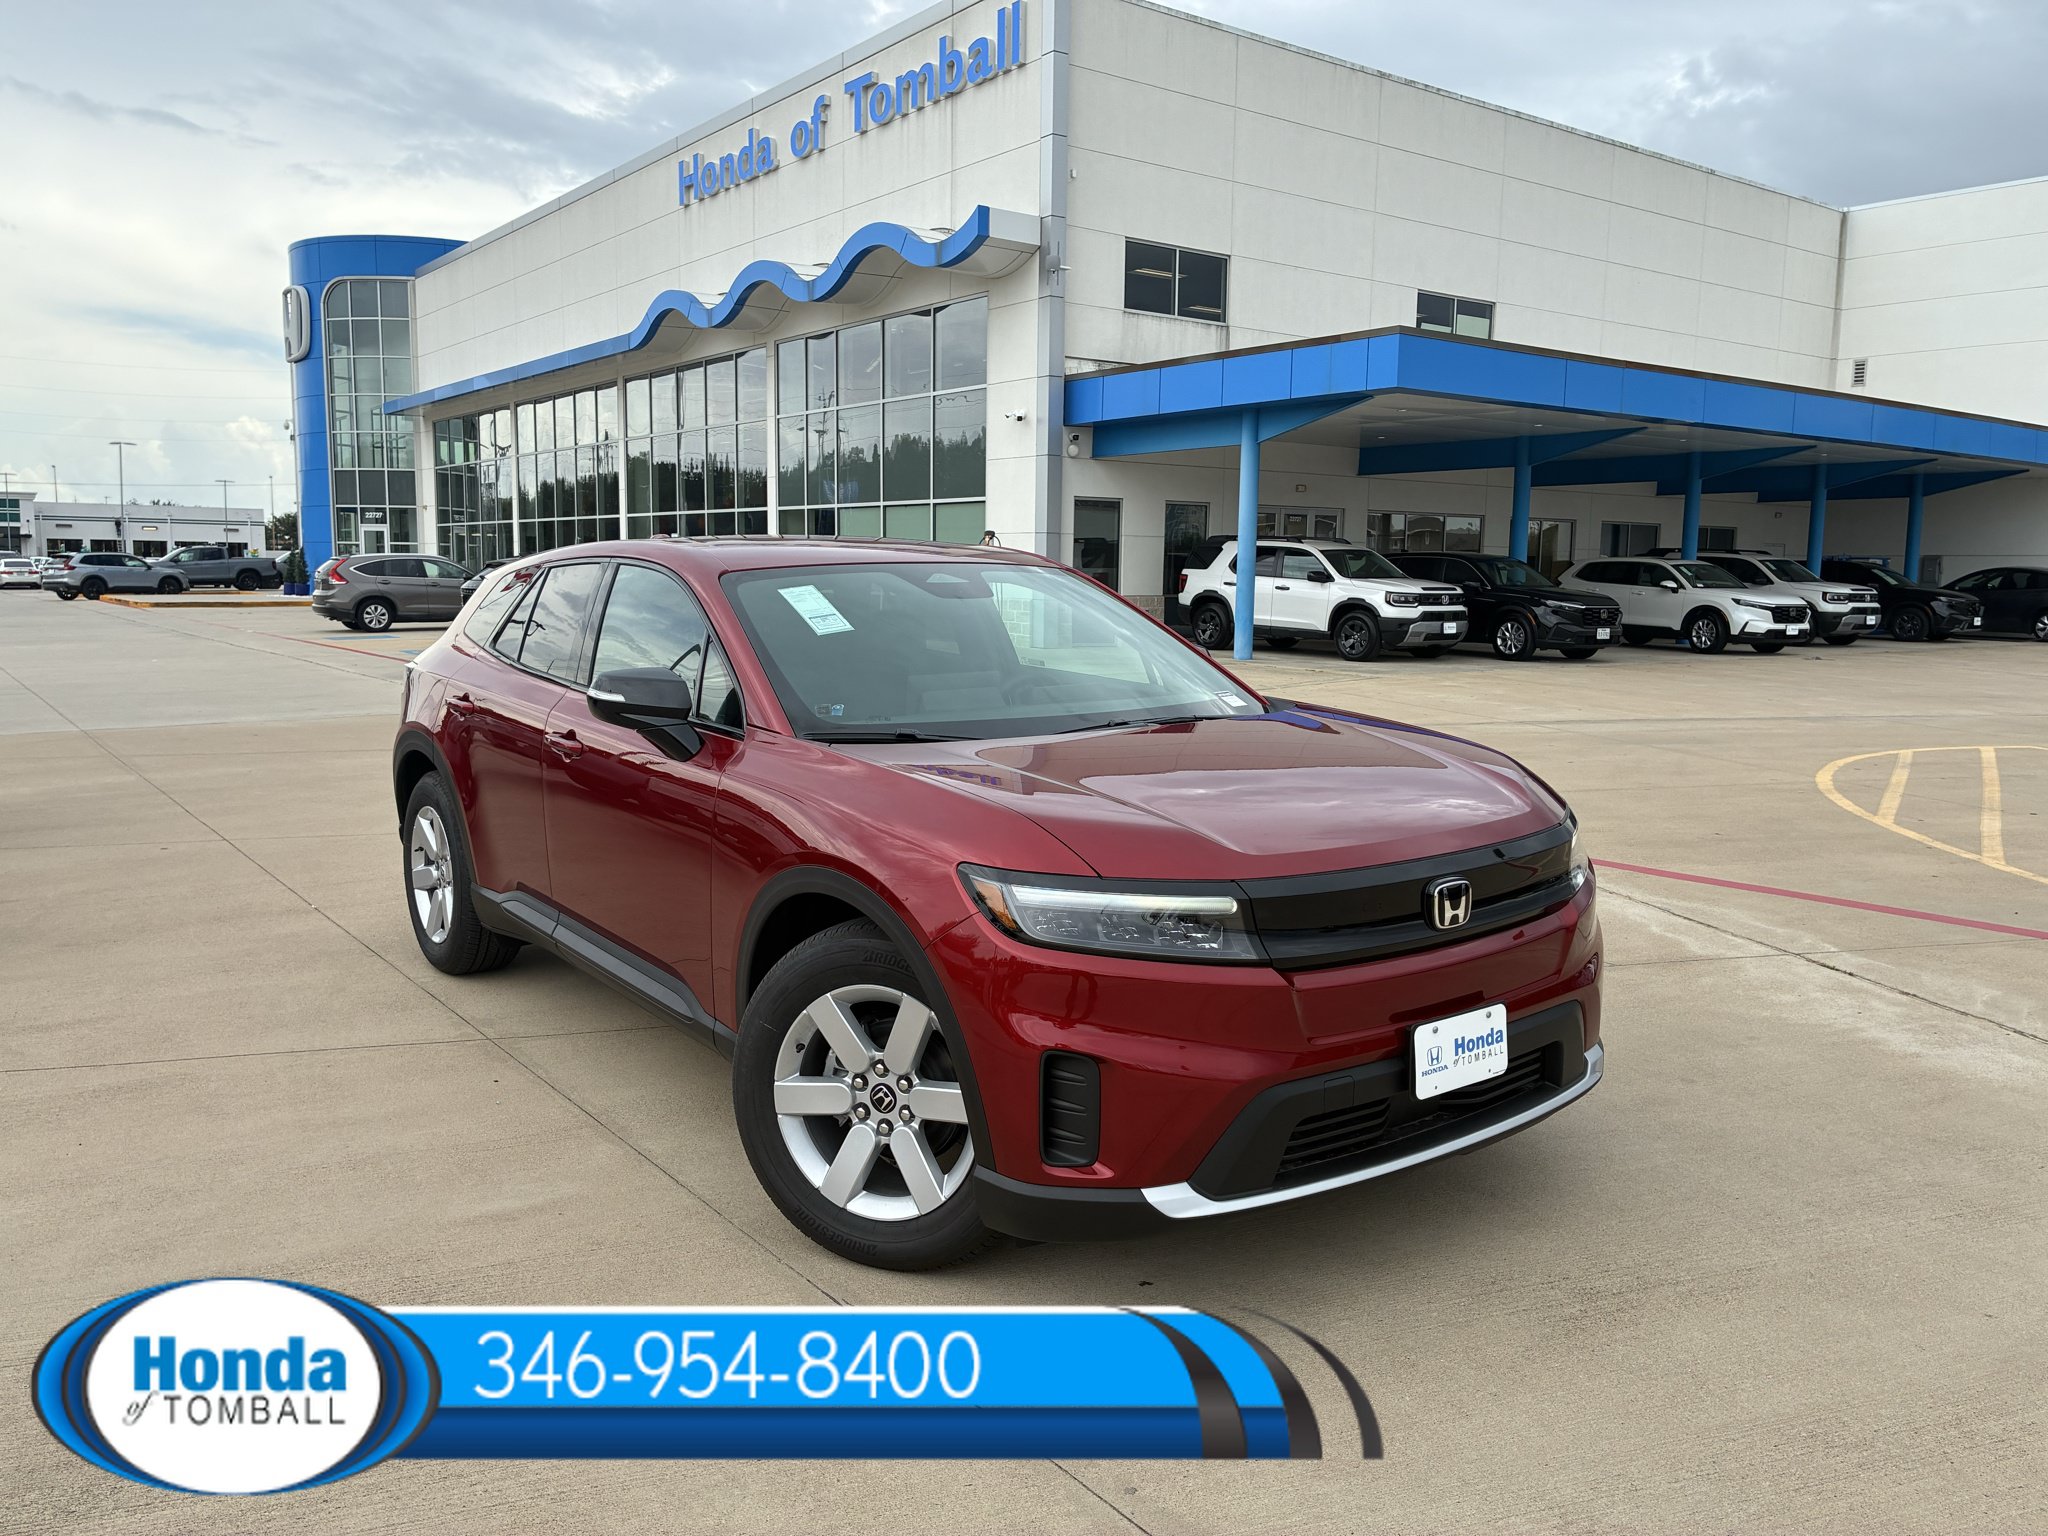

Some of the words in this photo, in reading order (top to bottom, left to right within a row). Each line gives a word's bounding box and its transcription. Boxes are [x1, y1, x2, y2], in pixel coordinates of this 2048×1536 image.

[678, 127, 779, 208] Honda
[790, 94, 831, 159] of
[844, 0, 1027, 135] Tomball
[1453, 1027, 1504, 1057] Honda
[1461, 1045, 1505, 1067] TOMBALL
[1421, 1064, 1449, 1078] HONDA
